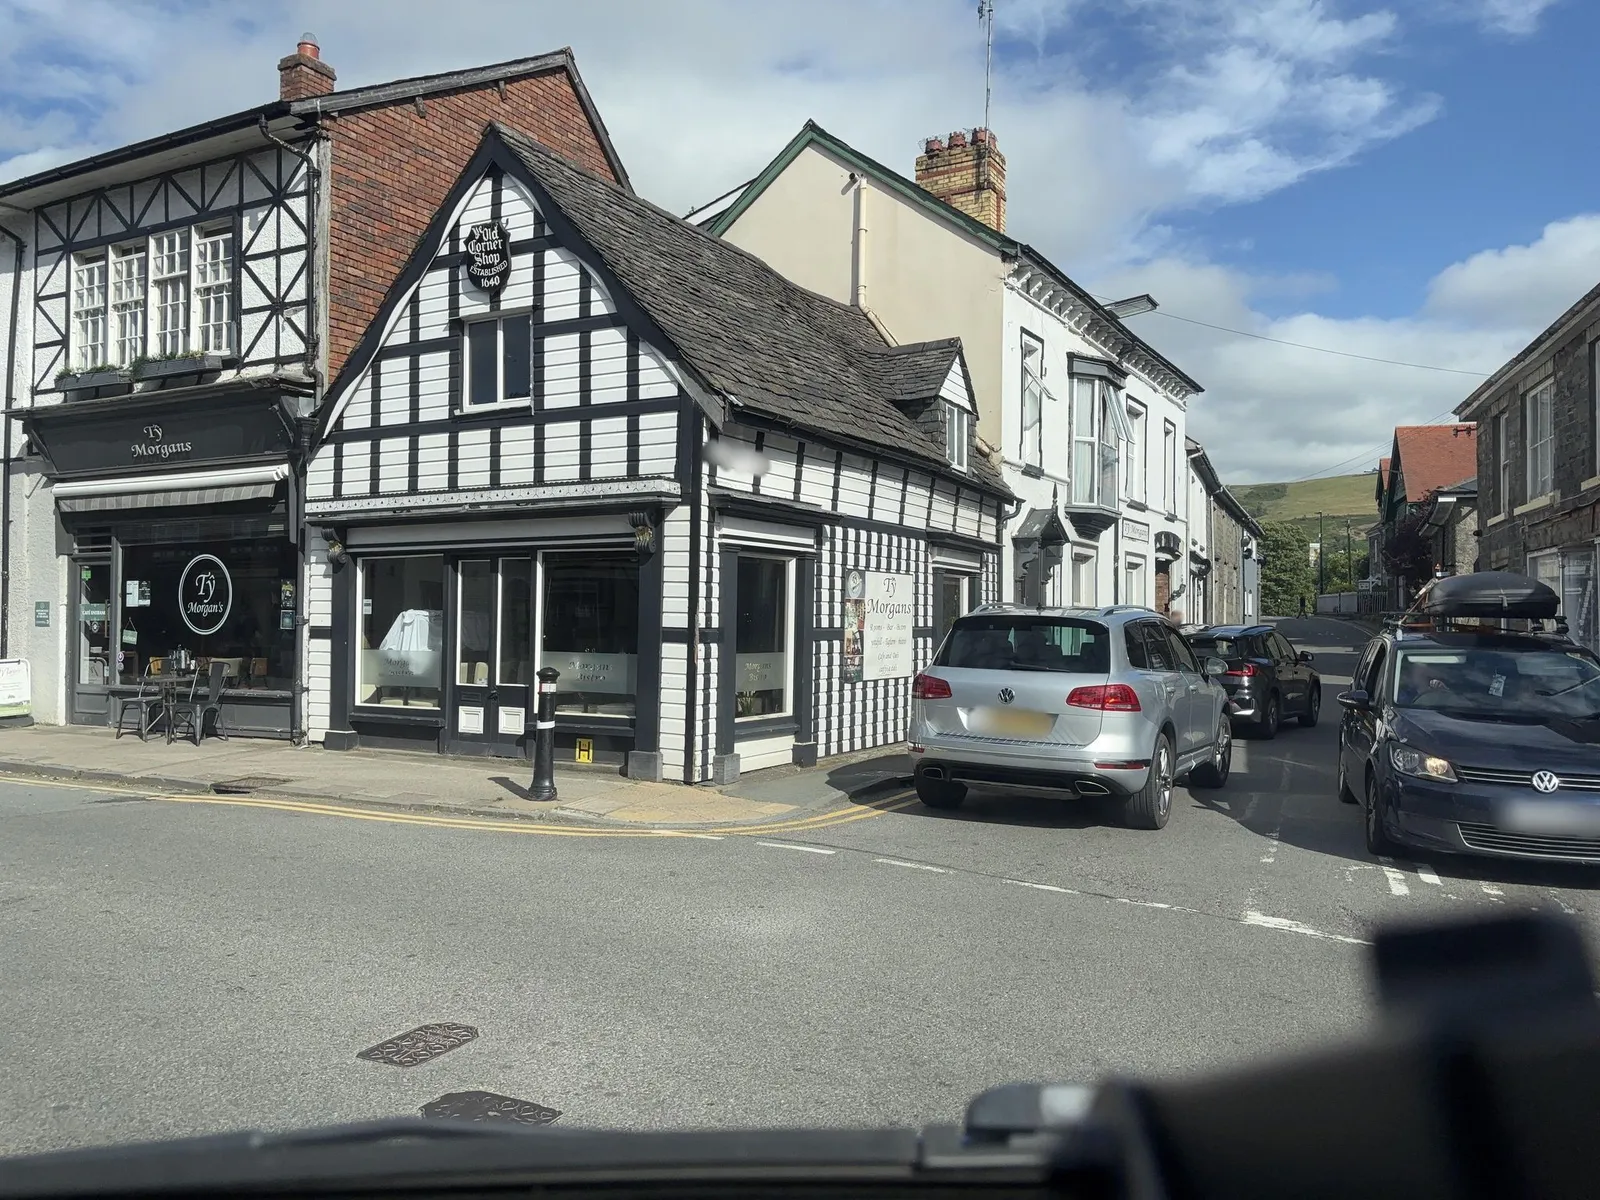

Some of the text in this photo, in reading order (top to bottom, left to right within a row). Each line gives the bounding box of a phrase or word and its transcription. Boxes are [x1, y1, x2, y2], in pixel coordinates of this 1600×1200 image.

[482, 223, 500, 241] Old
[468, 240, 503, 254] Corner
[474, 253, 500, 266] Shop
[469, 260, 508, 276] ESTABLISHED
[481, 276, 500, 287] 1640
[131, 441, 192, 458] Morgans
[187, 601, 224, 617] Morgan's
[867, 598, 912, 619] Morgans
